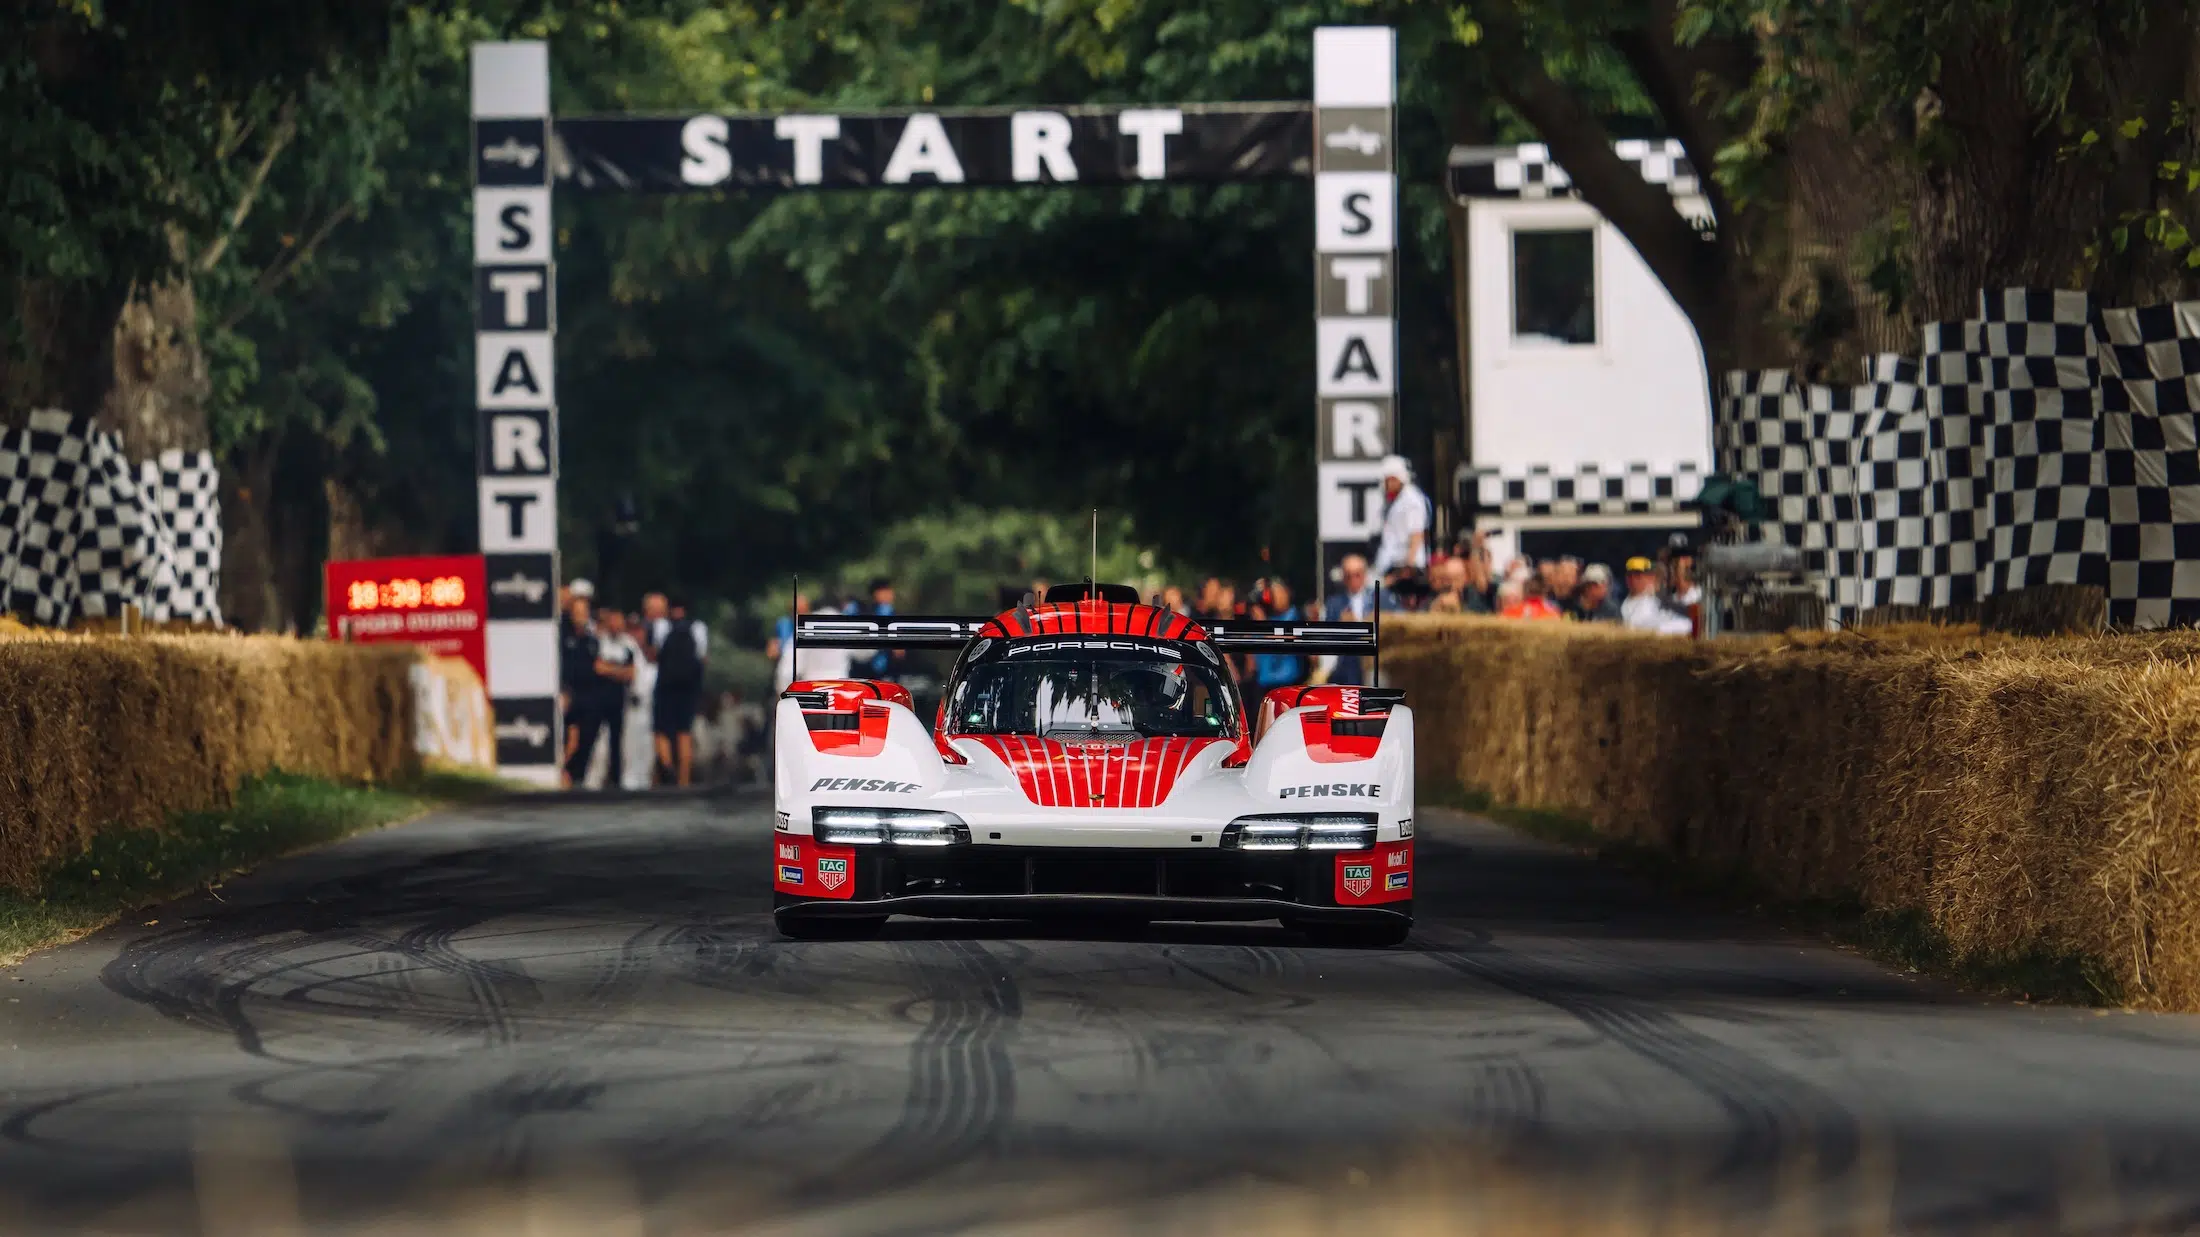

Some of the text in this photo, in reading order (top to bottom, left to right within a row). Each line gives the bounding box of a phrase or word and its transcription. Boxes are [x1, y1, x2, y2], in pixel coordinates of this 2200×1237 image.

[680, 109, 1183, 186] START
[1330, 191, 1383, 524] START
[489, 204, 546, 539] START
[1008, 641, 1182, 660] PORSCHE
[809, 777, 923, 794] PENSKE
[1279, 783, 1381, 799] PENSKE
[821, 861, 844, 872] TAG
[1346, 868, 1370, 878] TAG
[820, 873, 844, 888] HEUER
[1346, 880, 1370, 895] HEUER
